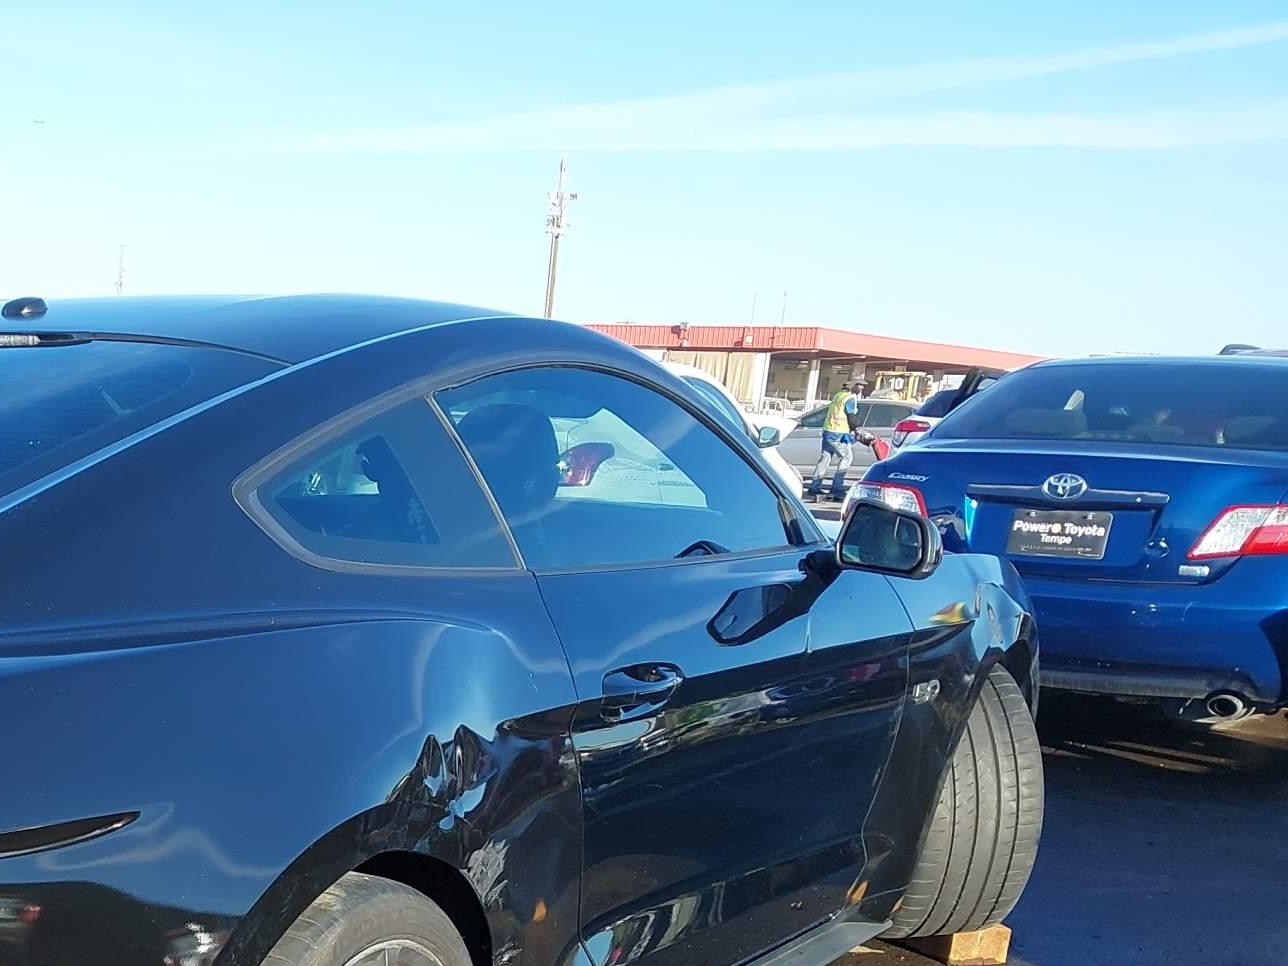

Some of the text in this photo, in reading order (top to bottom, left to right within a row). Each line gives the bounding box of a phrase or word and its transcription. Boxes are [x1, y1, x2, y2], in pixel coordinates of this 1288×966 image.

[887, 377, 905, 390] 10
[1012, 520, 1107, 537] Power Toyota
[1040, 533, 1073, 545] Tempe
